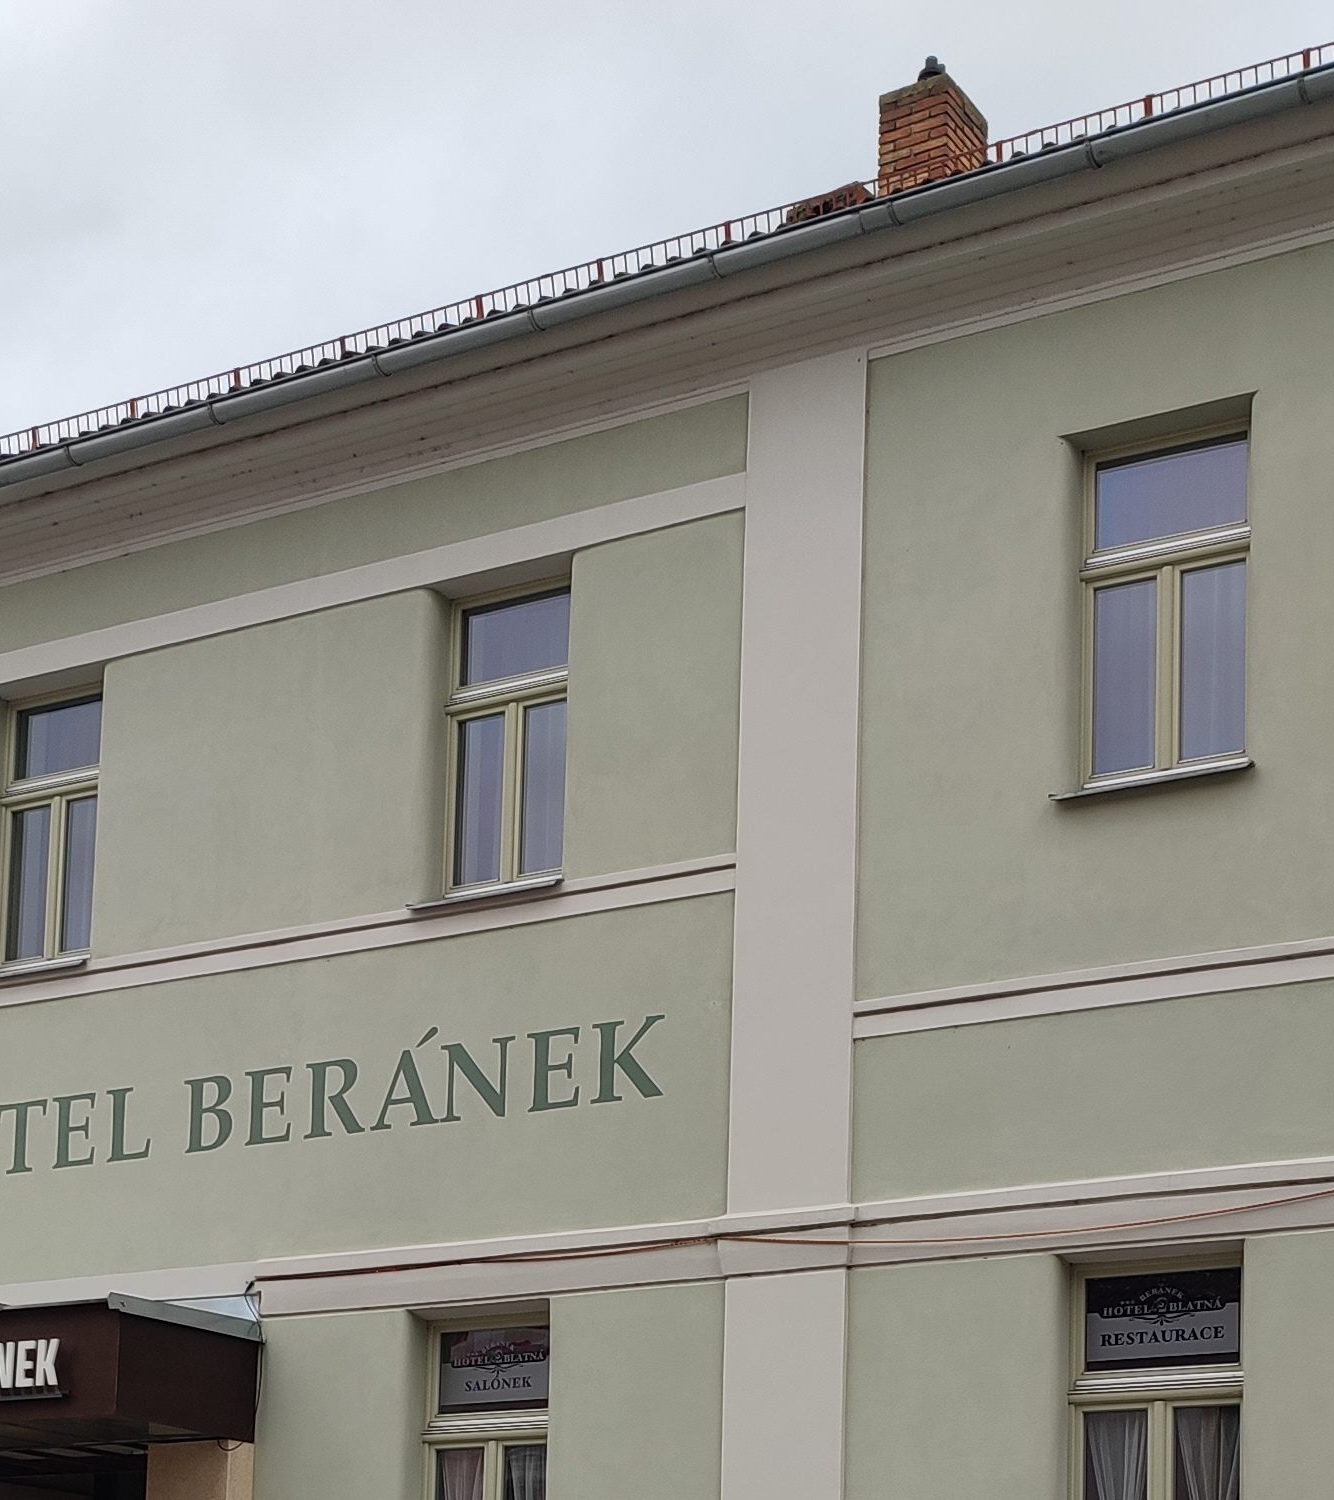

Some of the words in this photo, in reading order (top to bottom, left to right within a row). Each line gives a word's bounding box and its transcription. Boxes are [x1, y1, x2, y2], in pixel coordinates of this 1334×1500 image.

[184, 1014, 666, 1155] BERÁNEK
[1102, 1304, 1152, 1317] HOTEL
[1169, 1296, 1222, 1312] BLATNÁ
[1100, 1325, 1225, 1347] RESTAURACE
[453, 1356, 490, 1367] HOTEL
[503, 1350, 545, 1362] BLATNÁ
[464, 1375, 532, 1391] SALÓNEK
